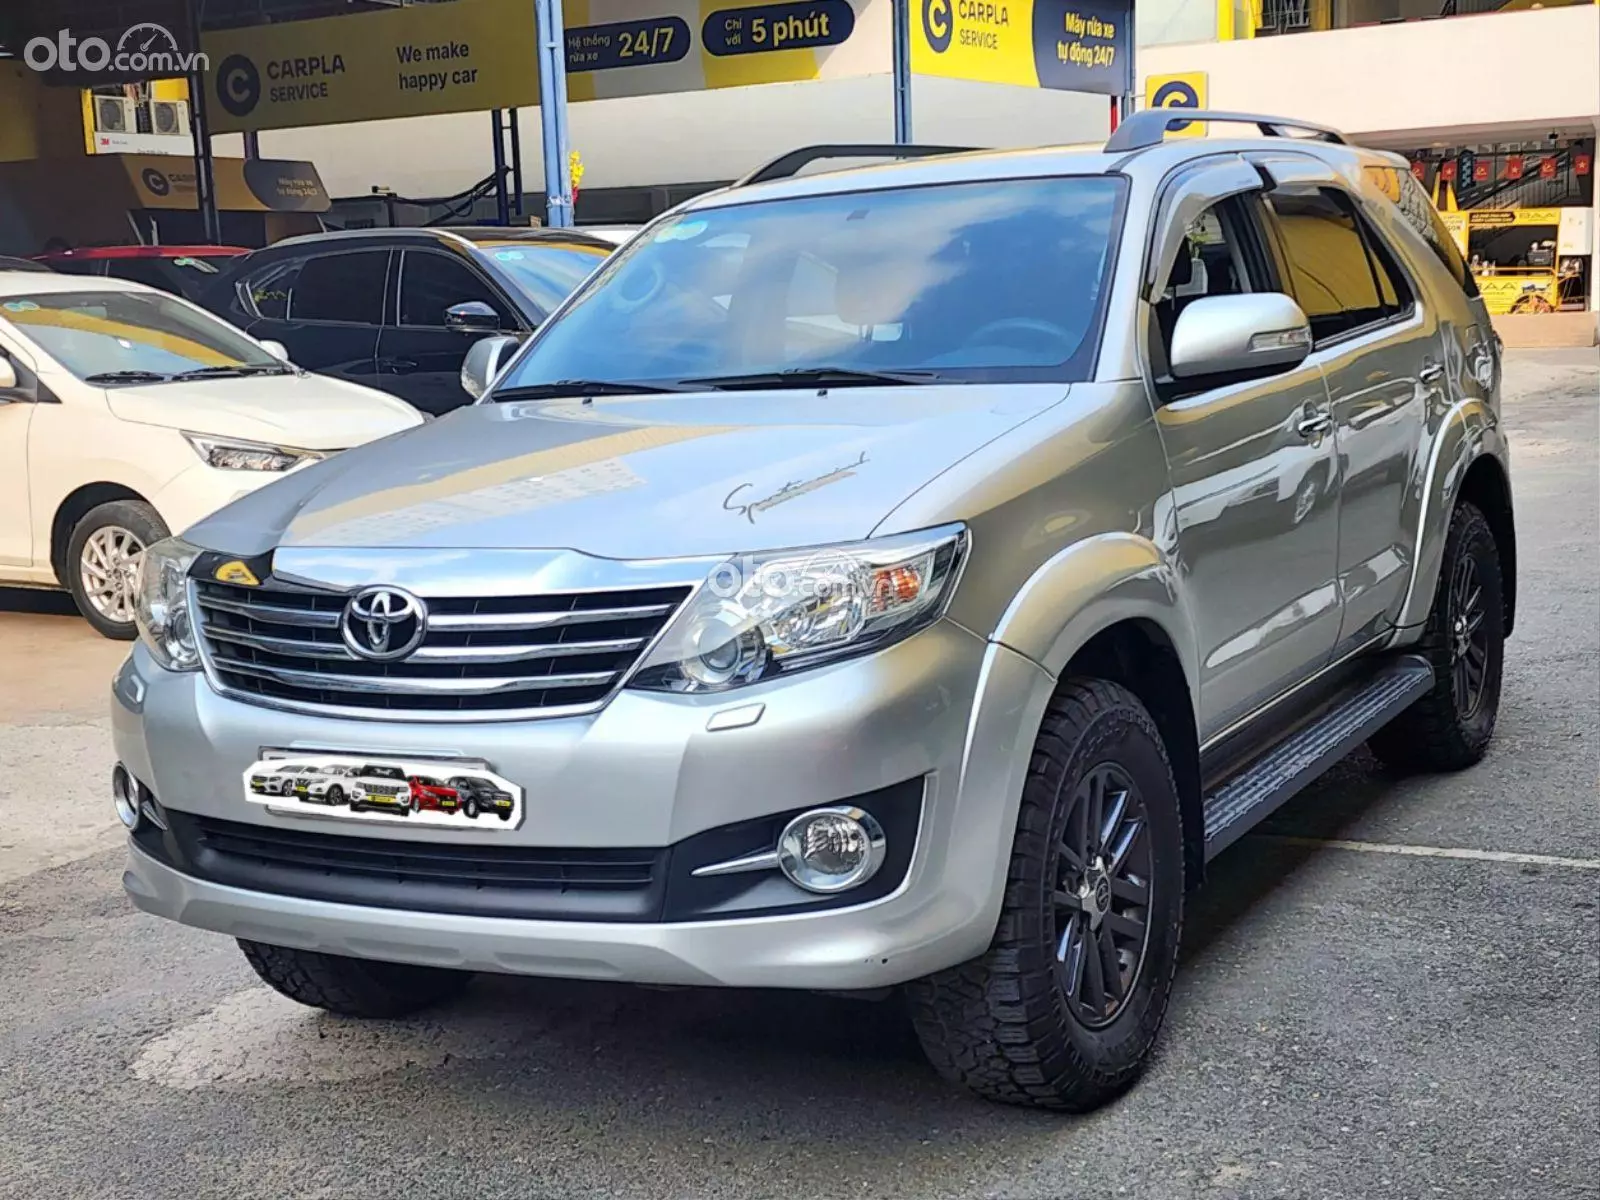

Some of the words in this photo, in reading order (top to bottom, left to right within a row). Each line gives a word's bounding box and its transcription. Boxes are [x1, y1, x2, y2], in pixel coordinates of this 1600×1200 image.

[958, 0, 1009, 27] CARPLA
[1065, 11, 1086, 39] Máy
[1103, 23, 1115, 39] xe
[619, 27, 674, 57] 24/7
[751, 18, 767, 43] 5
[773, 11, 830, 47] phút
[959, 28, 998, 50] SERVICE
[396, 46, 422, 64] We
[426, 41, 469, 60] make
[586, 52, 599, 61] xe
[1070, 41, 1093, 68] động
[1094, 45, 1115, 67] 24/7
[267, 54, 346, 80] CARPLA
[399, 72, 447, 92] happy
[451, 67, 478, 85] car
[269, 82, 329, 102] SERVICE
